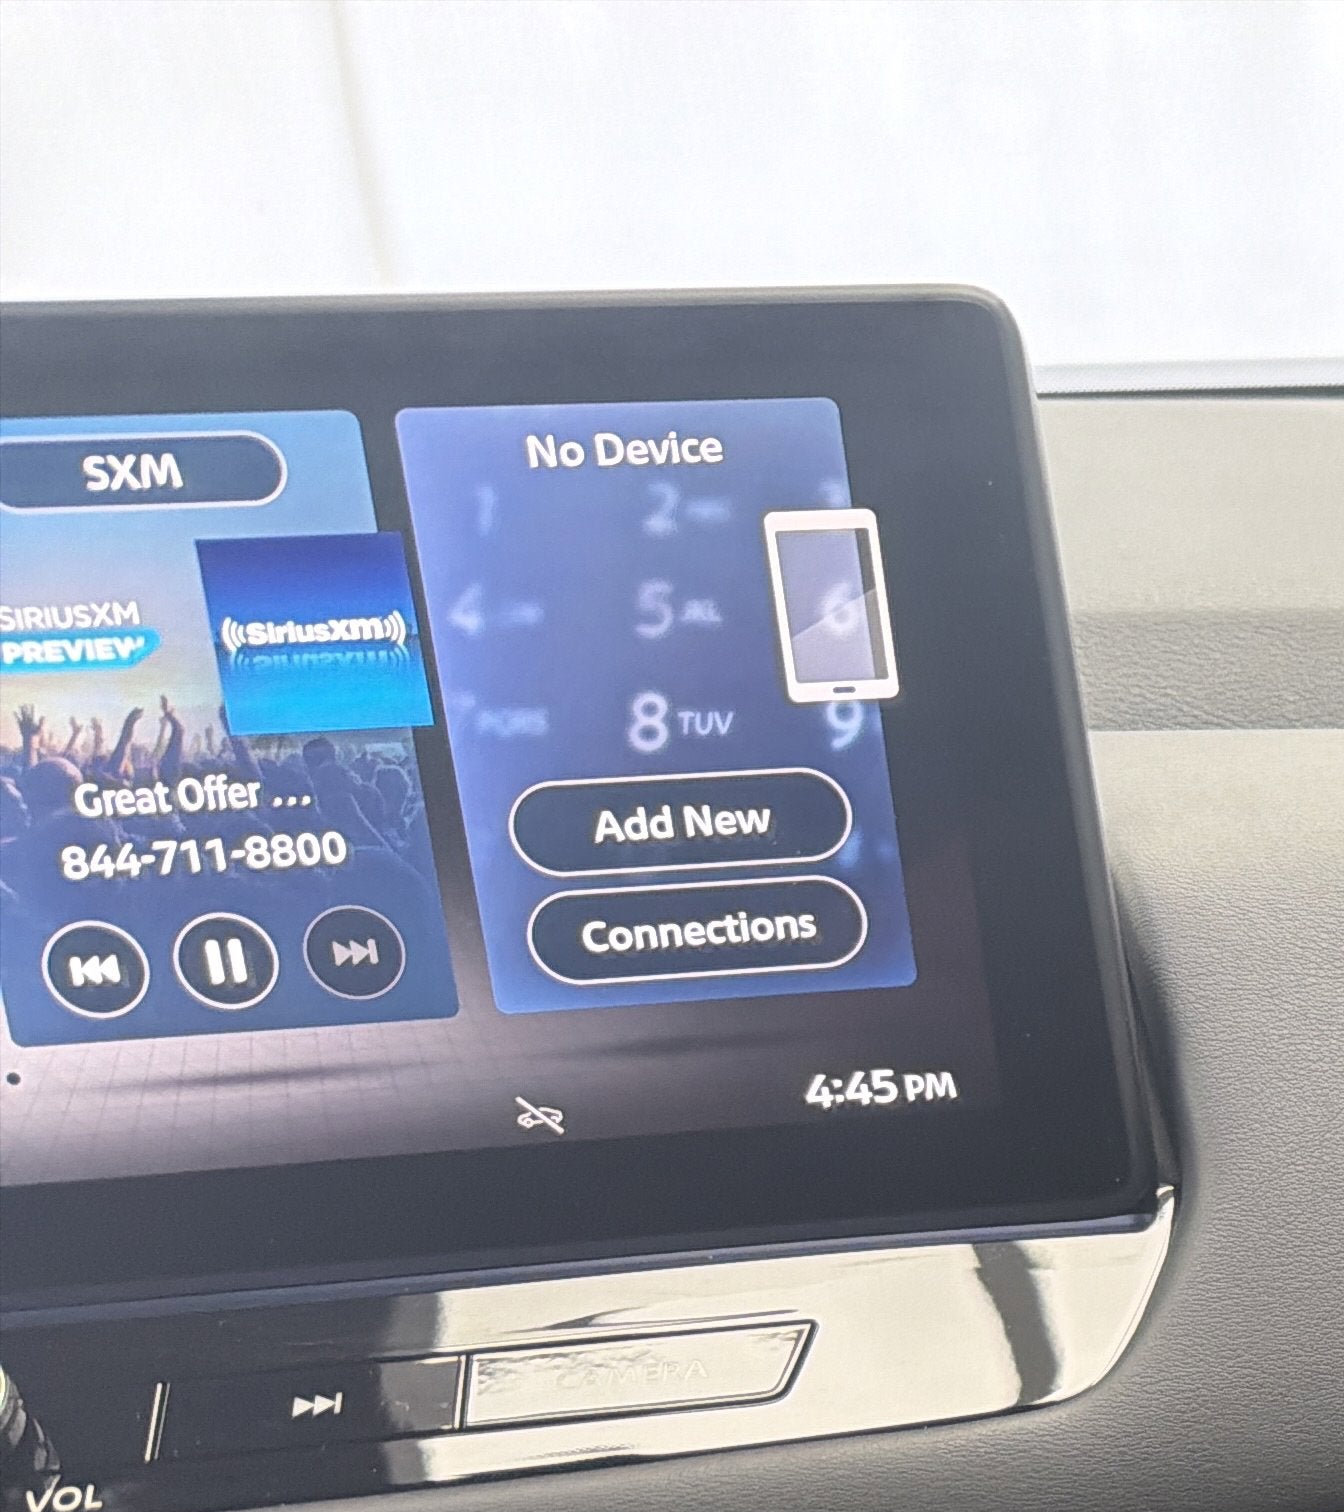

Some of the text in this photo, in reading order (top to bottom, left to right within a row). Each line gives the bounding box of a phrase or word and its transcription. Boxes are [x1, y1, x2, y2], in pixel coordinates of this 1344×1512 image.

[526, 430, 724, 469] No Device
[82, 453, 184, 491] SXM
[0, 601, 142, 631] SIRIUSXM
[2, 636, 145, 665] PREVIEW
[628, 689, 735, 753] 8 TUV
[74, 782, 173, 818] Great
[177, 773, 262, 812] Offer
[594, 803, 771, 844] Add New
[61, 830, 348, 881] 844-711-8800
[582, 911, 818, 953] Connections
[804, 1068, 958, 1108] 4:45 PM
[556, 1360, 709, 1388] CAMERA
